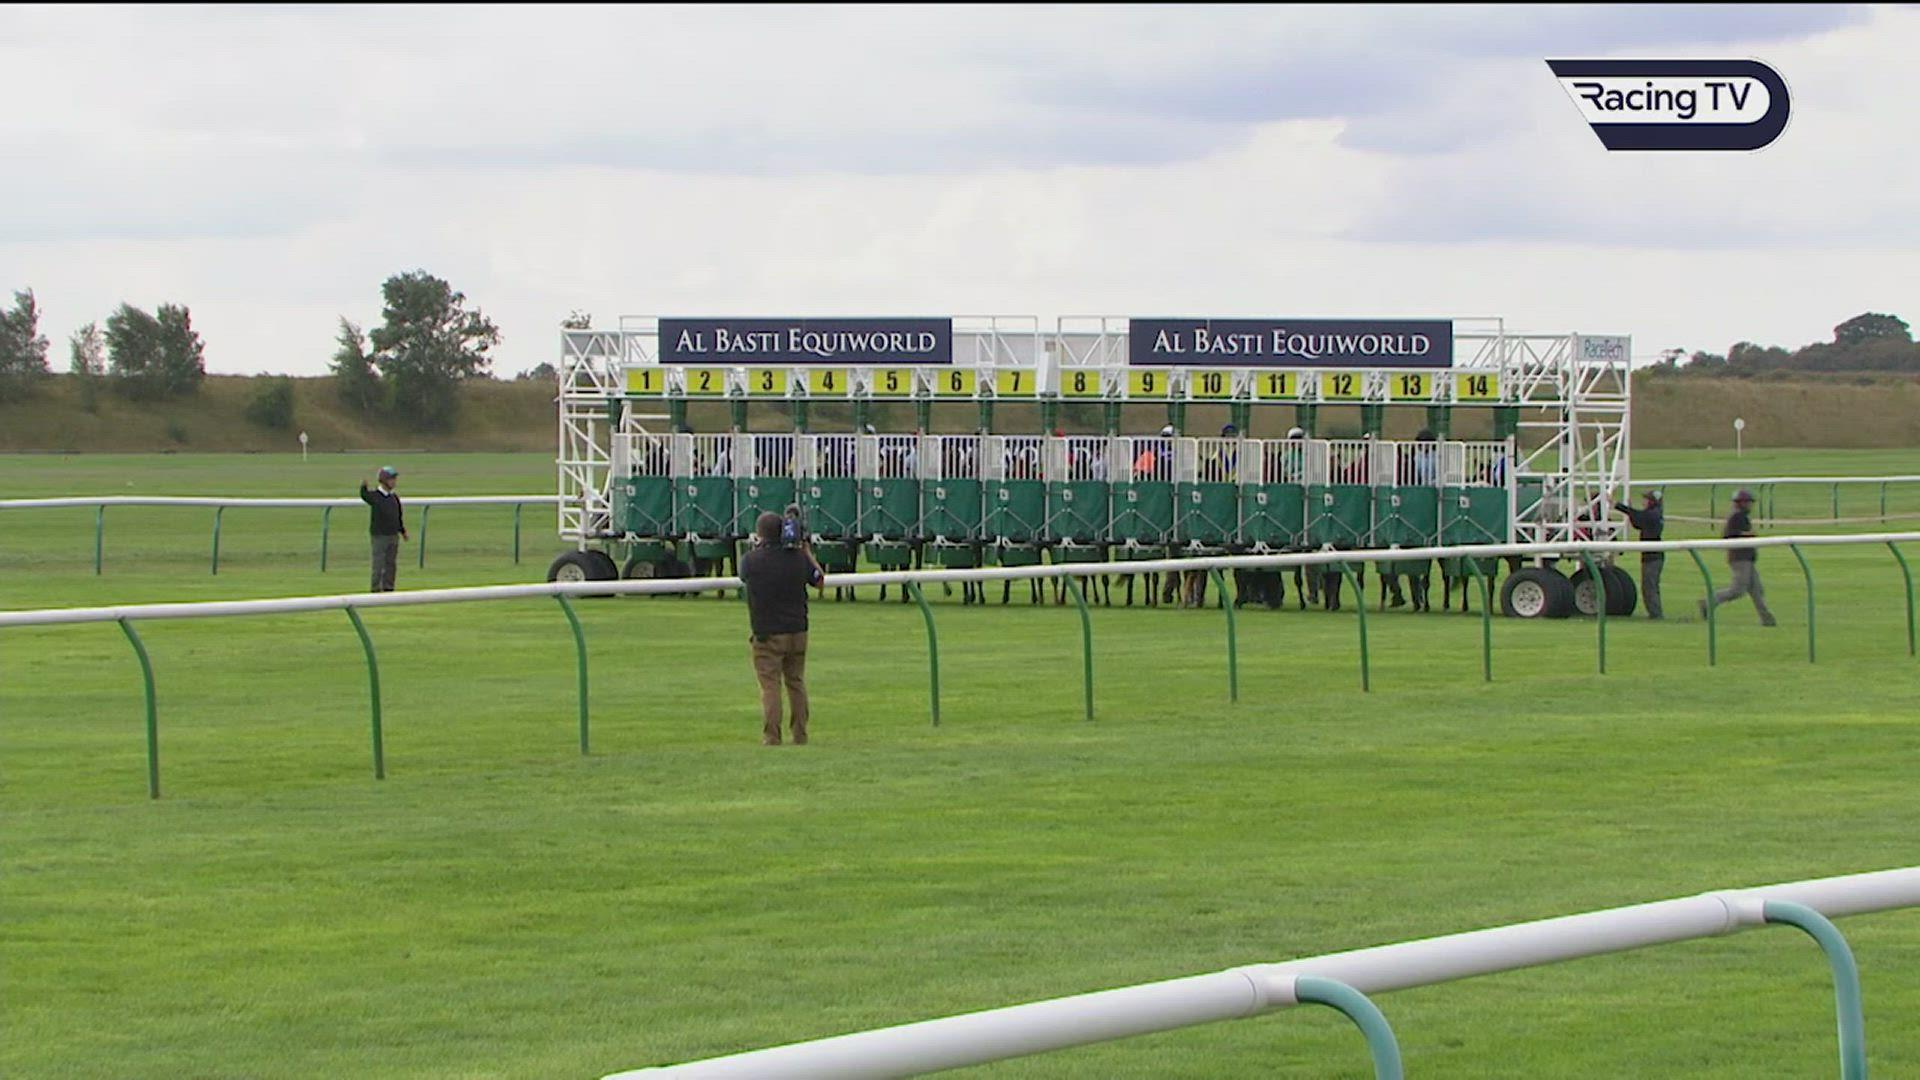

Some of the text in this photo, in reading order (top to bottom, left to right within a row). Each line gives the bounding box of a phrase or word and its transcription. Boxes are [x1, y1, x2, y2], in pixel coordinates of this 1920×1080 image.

[641, 371, 650, 390] 1
[700, 370, 711, 391] 2
[762, 370, 773, 391] 3
[822, 371, 834, 391] 4
[886, 371, 898, 392] 5
[951, 371, 962, 392] 6
[1011, 371, 1021, 392] 7
[1074, 371, 1086, 393] 8
[1142, 372, 1154, 393] 9
[1202, 372, 1222, 394] 10
[1268, 373, 1286, 395] 11
[1332, 374, 1353, 396] 12
[1401, 375, 1422, 396] 13
[1467, 375, 1489, 397] 14
